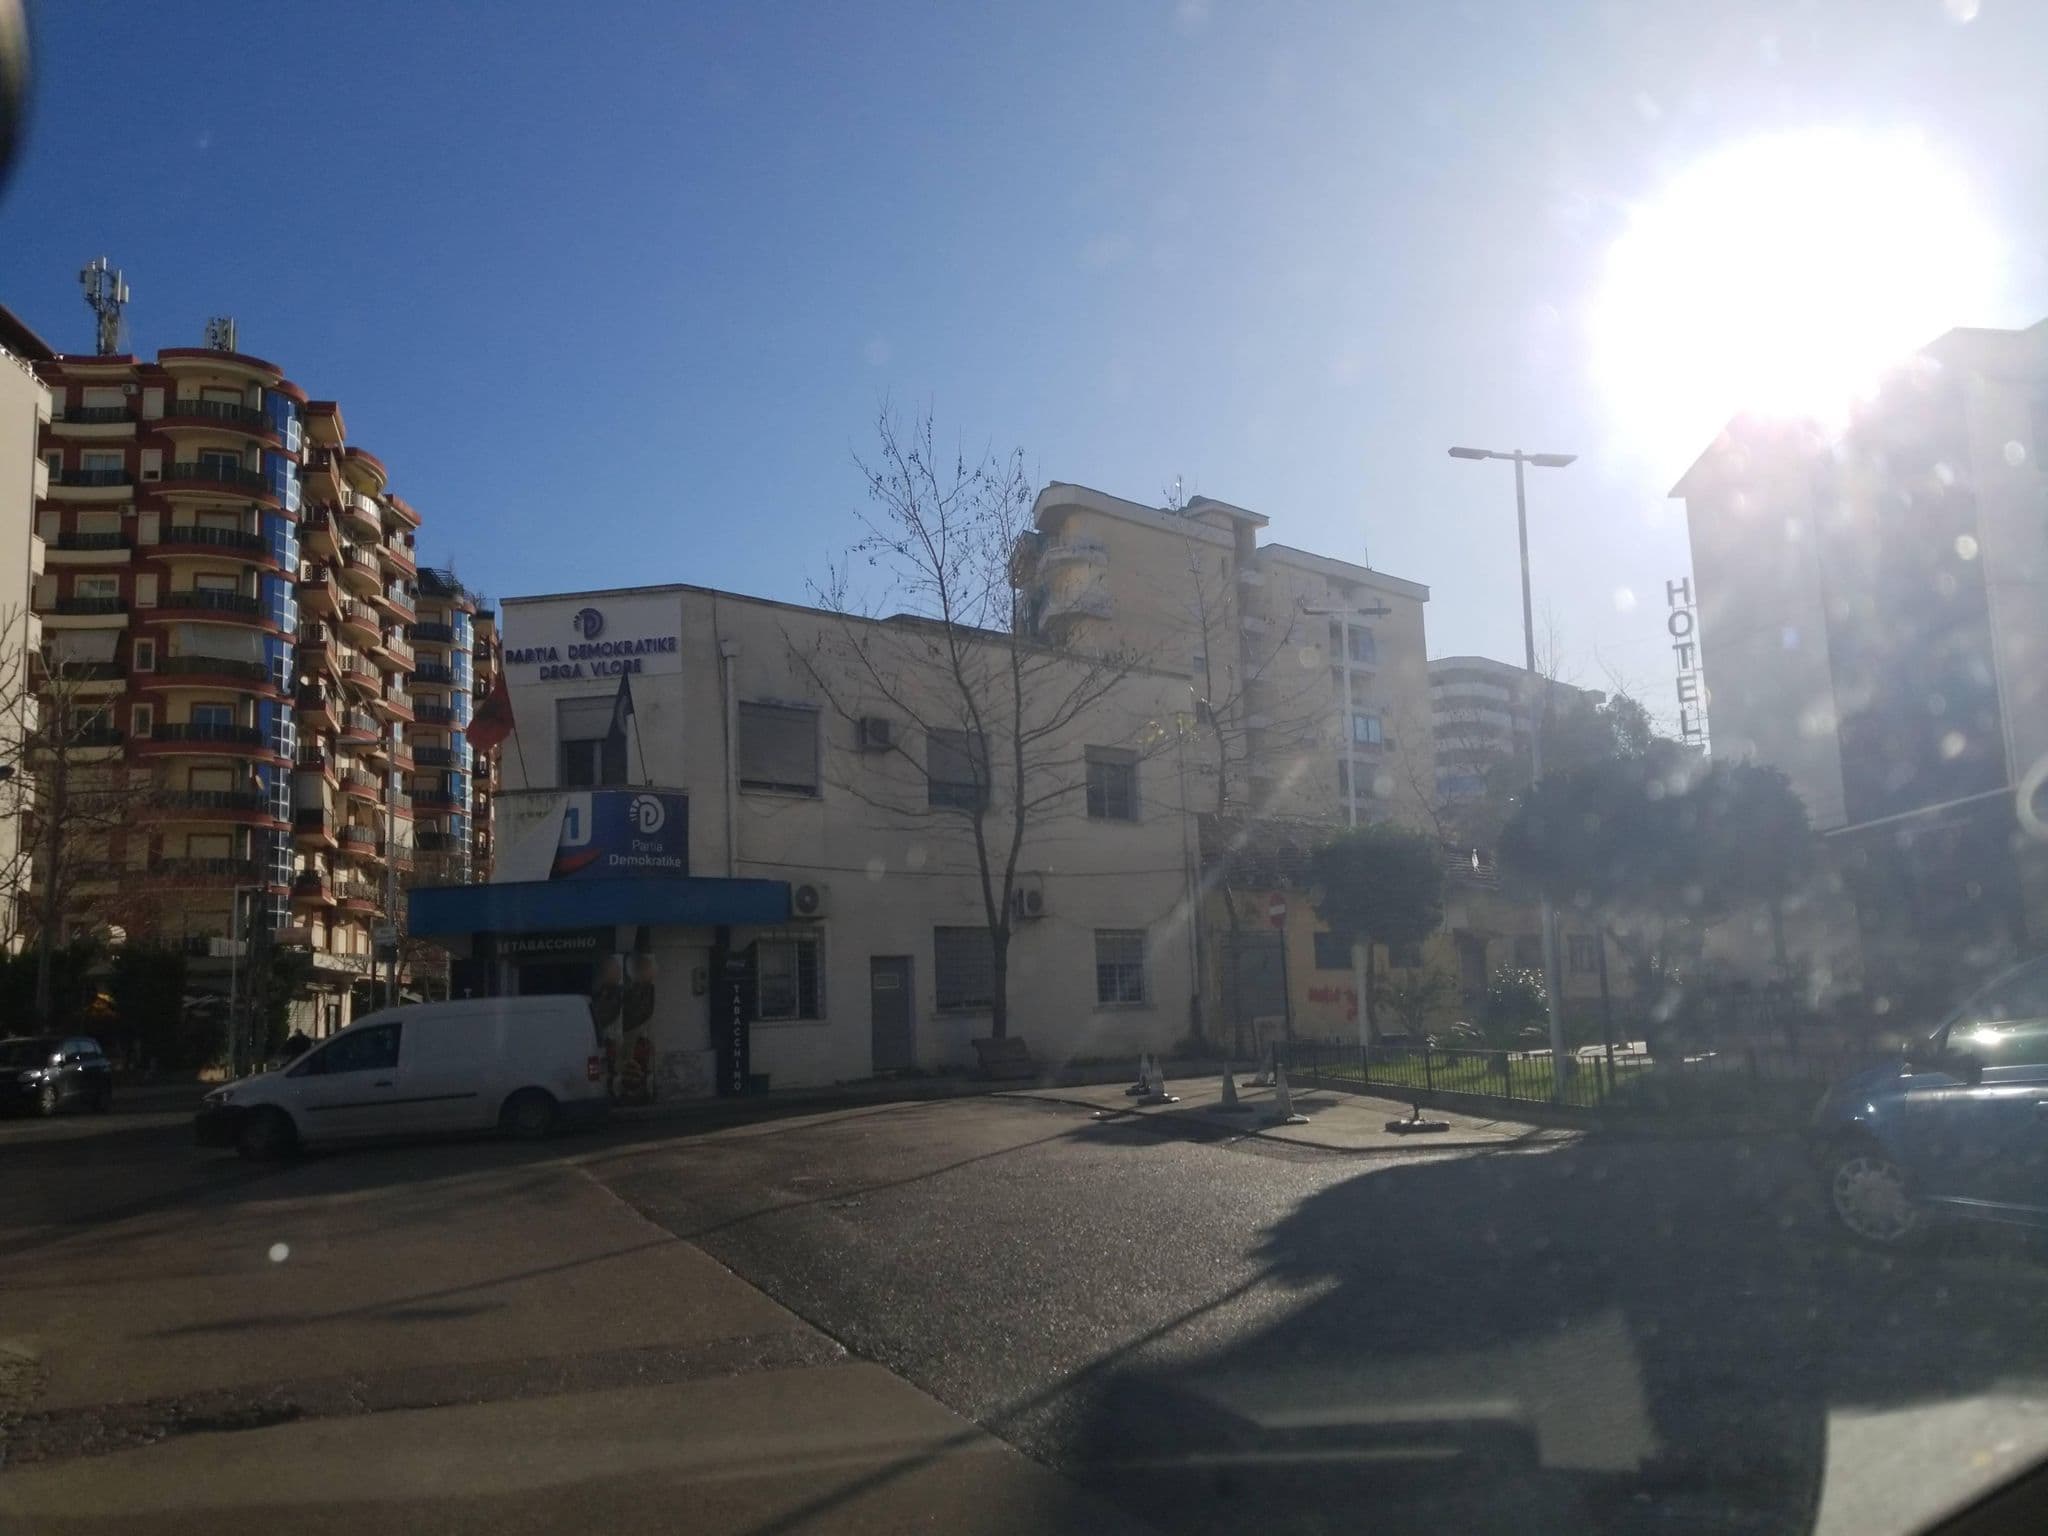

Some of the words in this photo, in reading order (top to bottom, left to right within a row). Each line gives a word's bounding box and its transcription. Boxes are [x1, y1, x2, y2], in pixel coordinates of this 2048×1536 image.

[505, 647, 560, 664] PARTIA
[568, 636, 677, 660] DEMOKRATIKE
[1666, 577, 1702, 735] HOTEL
[539, 664, 583, 680] DEGA
[632, 839, 663, 852] Partia
[609, 853, 681, 868] Demokratike
[733, 983, 742, 1090] TABACCHINO
